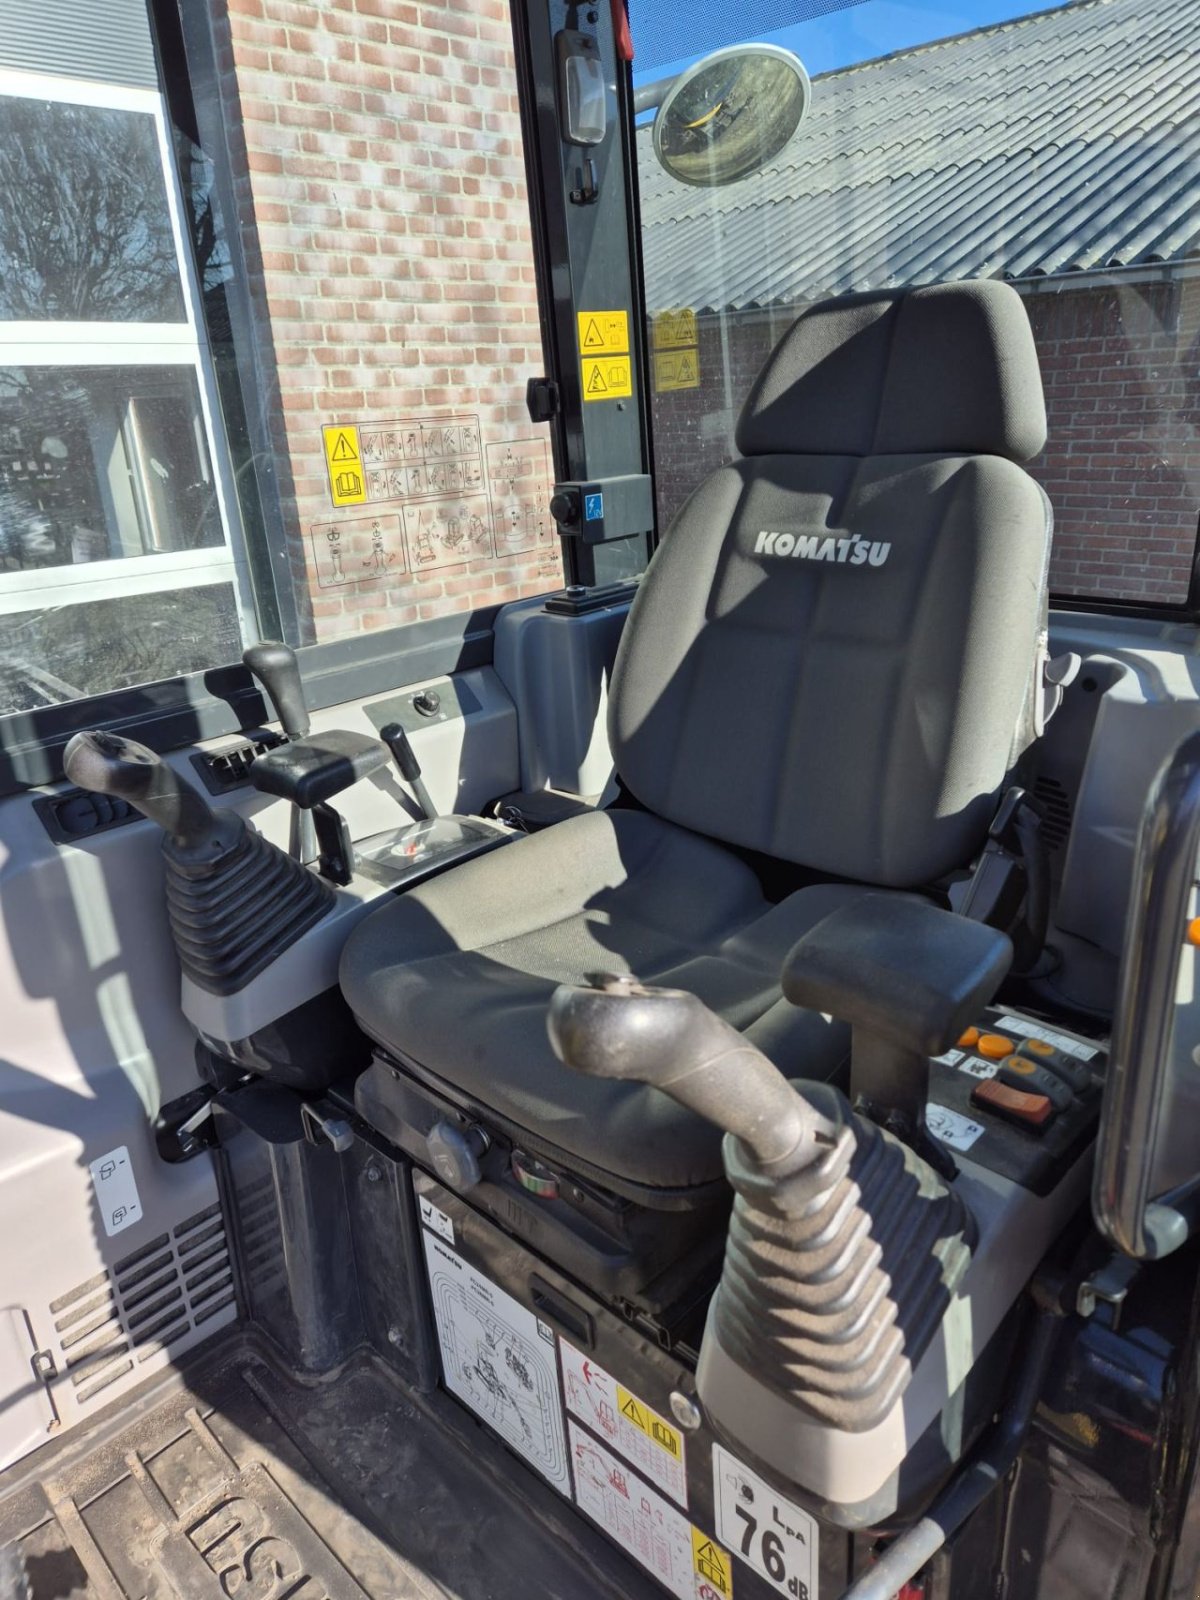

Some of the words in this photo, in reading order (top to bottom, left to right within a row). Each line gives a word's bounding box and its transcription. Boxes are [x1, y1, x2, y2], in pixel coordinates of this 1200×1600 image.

[754, 531, 891, 567] KOMATSU
[735, 1503, 786, 1583] 76
[788, 1575, 808, 1600] dB
